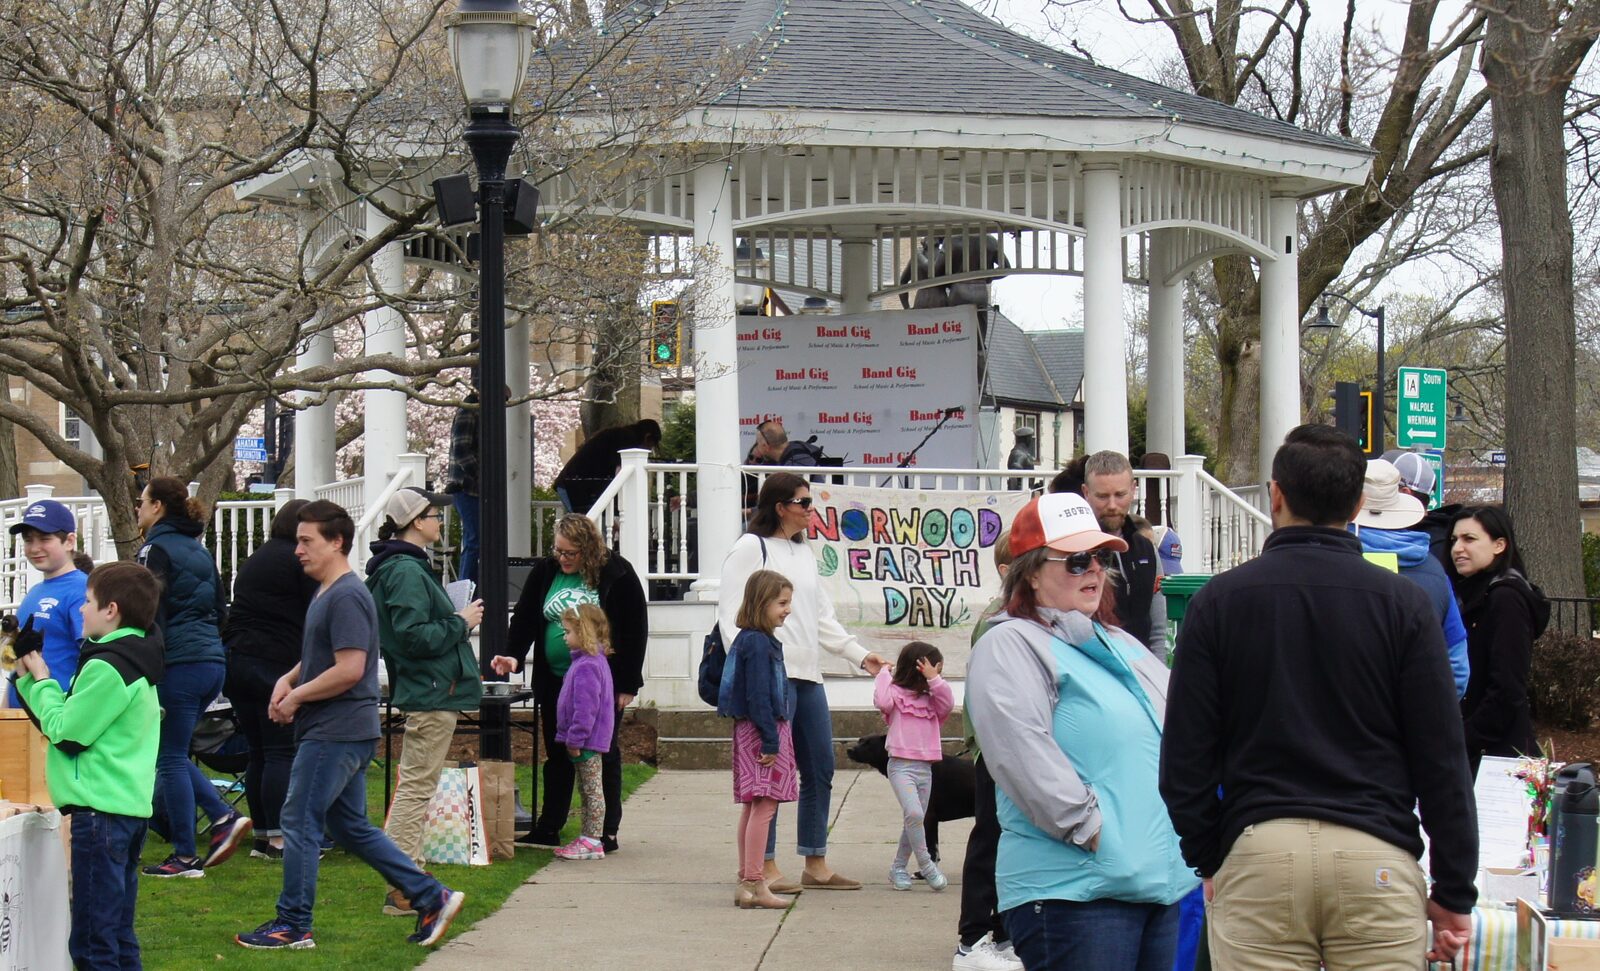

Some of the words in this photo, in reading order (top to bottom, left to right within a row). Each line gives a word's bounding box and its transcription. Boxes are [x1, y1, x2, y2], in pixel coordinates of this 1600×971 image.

[736, 329, 759, 341] and
[762, 328, 782, 342] Gig
[817, 326, 847, 337] Band
[851, 326, 871, 341] Gig
[908, 323, 939, 335] Band
[942, 321, 962, 334] Gig
[776, 368, 805, 380] Band
[809, 367, 829, 382] Gig
[861, 367, 893, 379] Band
[896, 366, 917, 381] Gig
[1423, 373, 1441, 385] SOUTH
[1406, 379, 1417, 393] 1A
[910, 409, 941, 421] Band
[945, 408, 964, 421] ig
[1409, 402, 1434, 413] WALPOLE
[739, 414, 760, 425] and
[818, 411, 849, 423] Band
[853, 411, 872, 426] Gig
[1407, 415, 1437, 426] WRENTHAM
[863, 453, 893, 465] Band
[896, 451, 917, 465] Gg
[807, 506, 1003, 549] NORWOOD
[848, 547, 981, 588] EARTH
[883, 587, 956, 628] DAY
